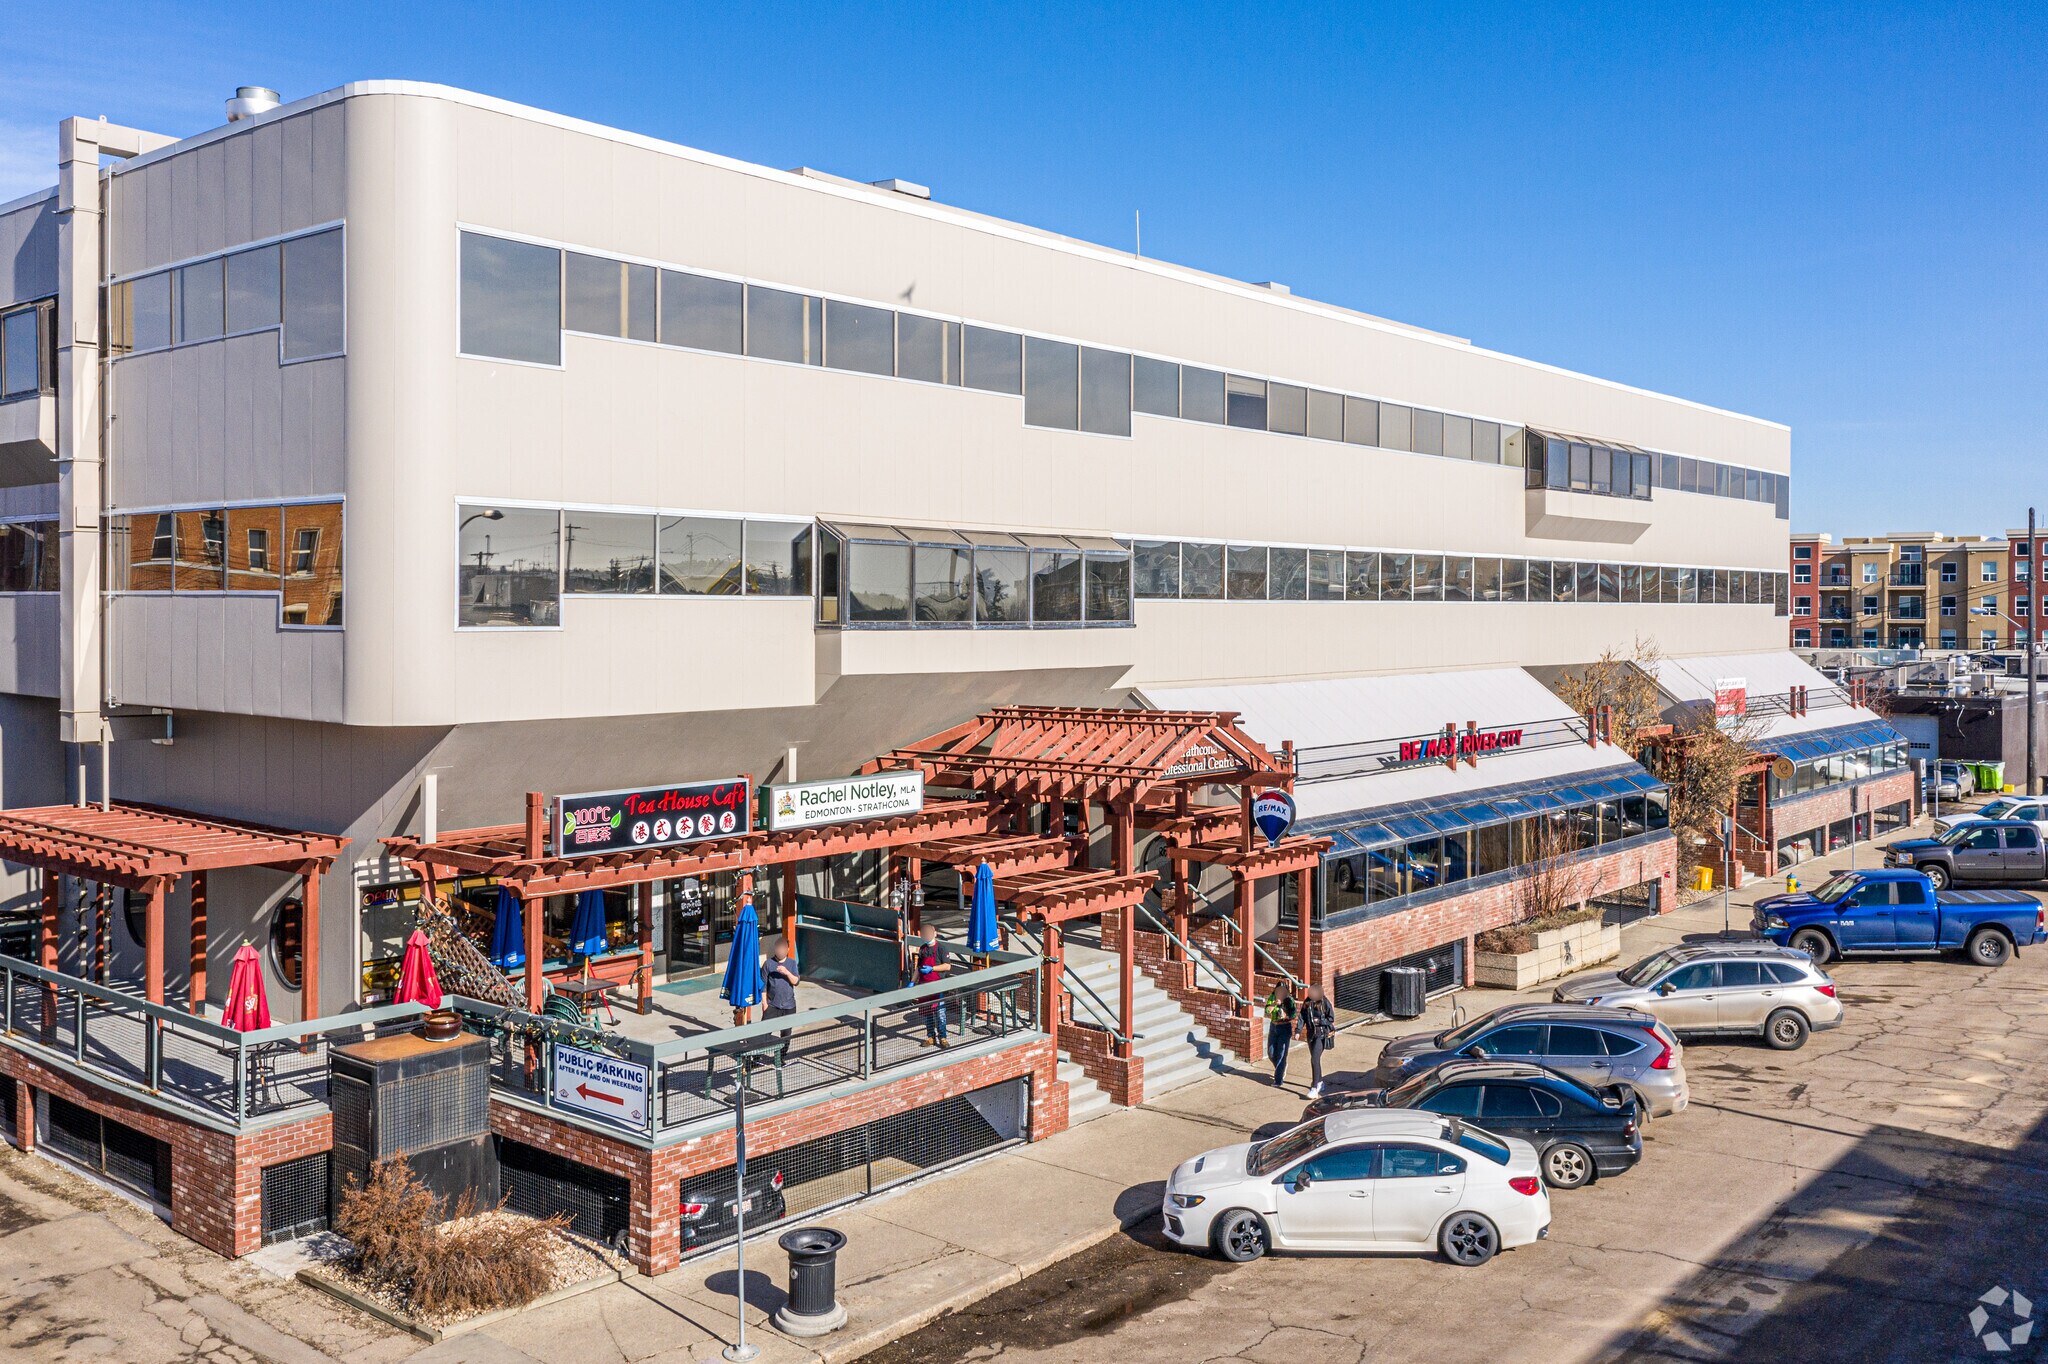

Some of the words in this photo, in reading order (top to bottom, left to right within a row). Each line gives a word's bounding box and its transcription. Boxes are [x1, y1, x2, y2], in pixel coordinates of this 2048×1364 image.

[1401, 736, 1457, 762] RE/MAX
[1462, 732, 1497, 753] RIVER
[1499, 729, 1523, 748] CITY
[624, 793, 655, 816] Tea
[657, 790, 709, 812] House
[712, 782, 745, 811] Café
[800, 785, 847, 806] Rachel
[850, 781, 897, 801] Notley,
[900, 785, 916, 795] MLA
[858, 799, 910, 813] STRATHCONA
[1258, 804, 1287, 815] RE/MAX
[362, 888, 399, 906] OPEN
[558, 1051, 594, 1071] PUBLIC
[596, 1063, 643, 1084] PARKING
[558, 1064, 575, 1074] AFTER
[581, 1070, 588, 1078] PM
[589, 1073, 600, 1081] AND
[602, 1076, 610, 1084] ON
[611, 1078, 643, 1093] WEEKENDS
